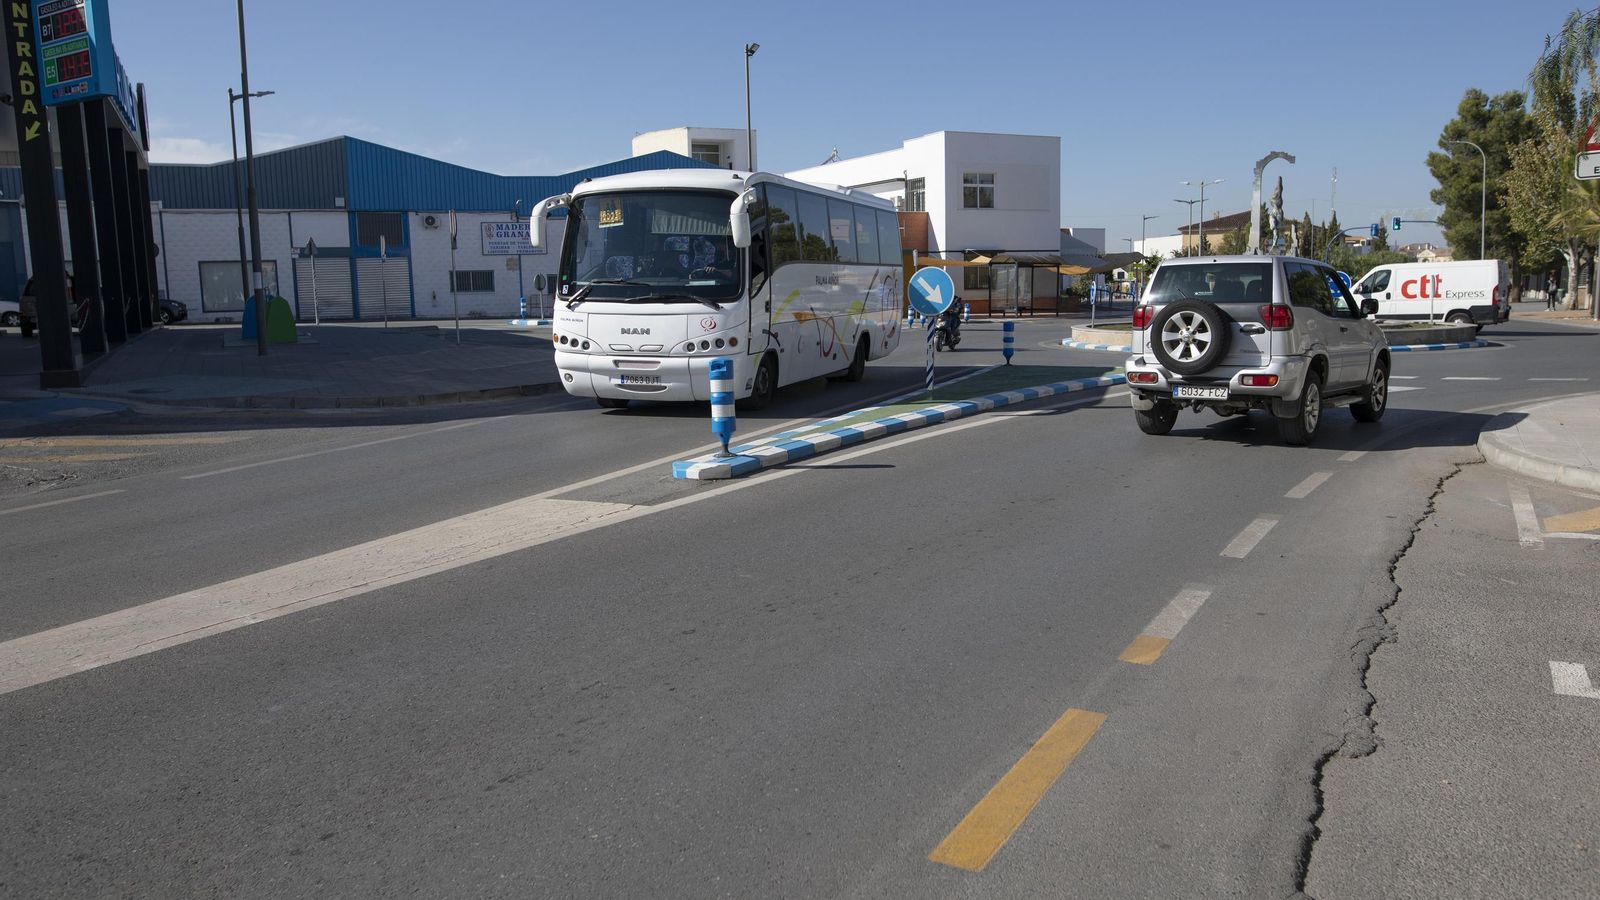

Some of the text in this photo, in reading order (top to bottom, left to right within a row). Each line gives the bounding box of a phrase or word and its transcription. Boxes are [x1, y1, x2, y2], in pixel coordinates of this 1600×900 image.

[42, 24, 51, 36] B7
[46, 66, 55, 78] E5
[1401, 273, 1485, 299] ctt Express
[625, 375, 660, 384] 7063 DJT
[1181, 387, 1227, 397] 6032 FCZ
